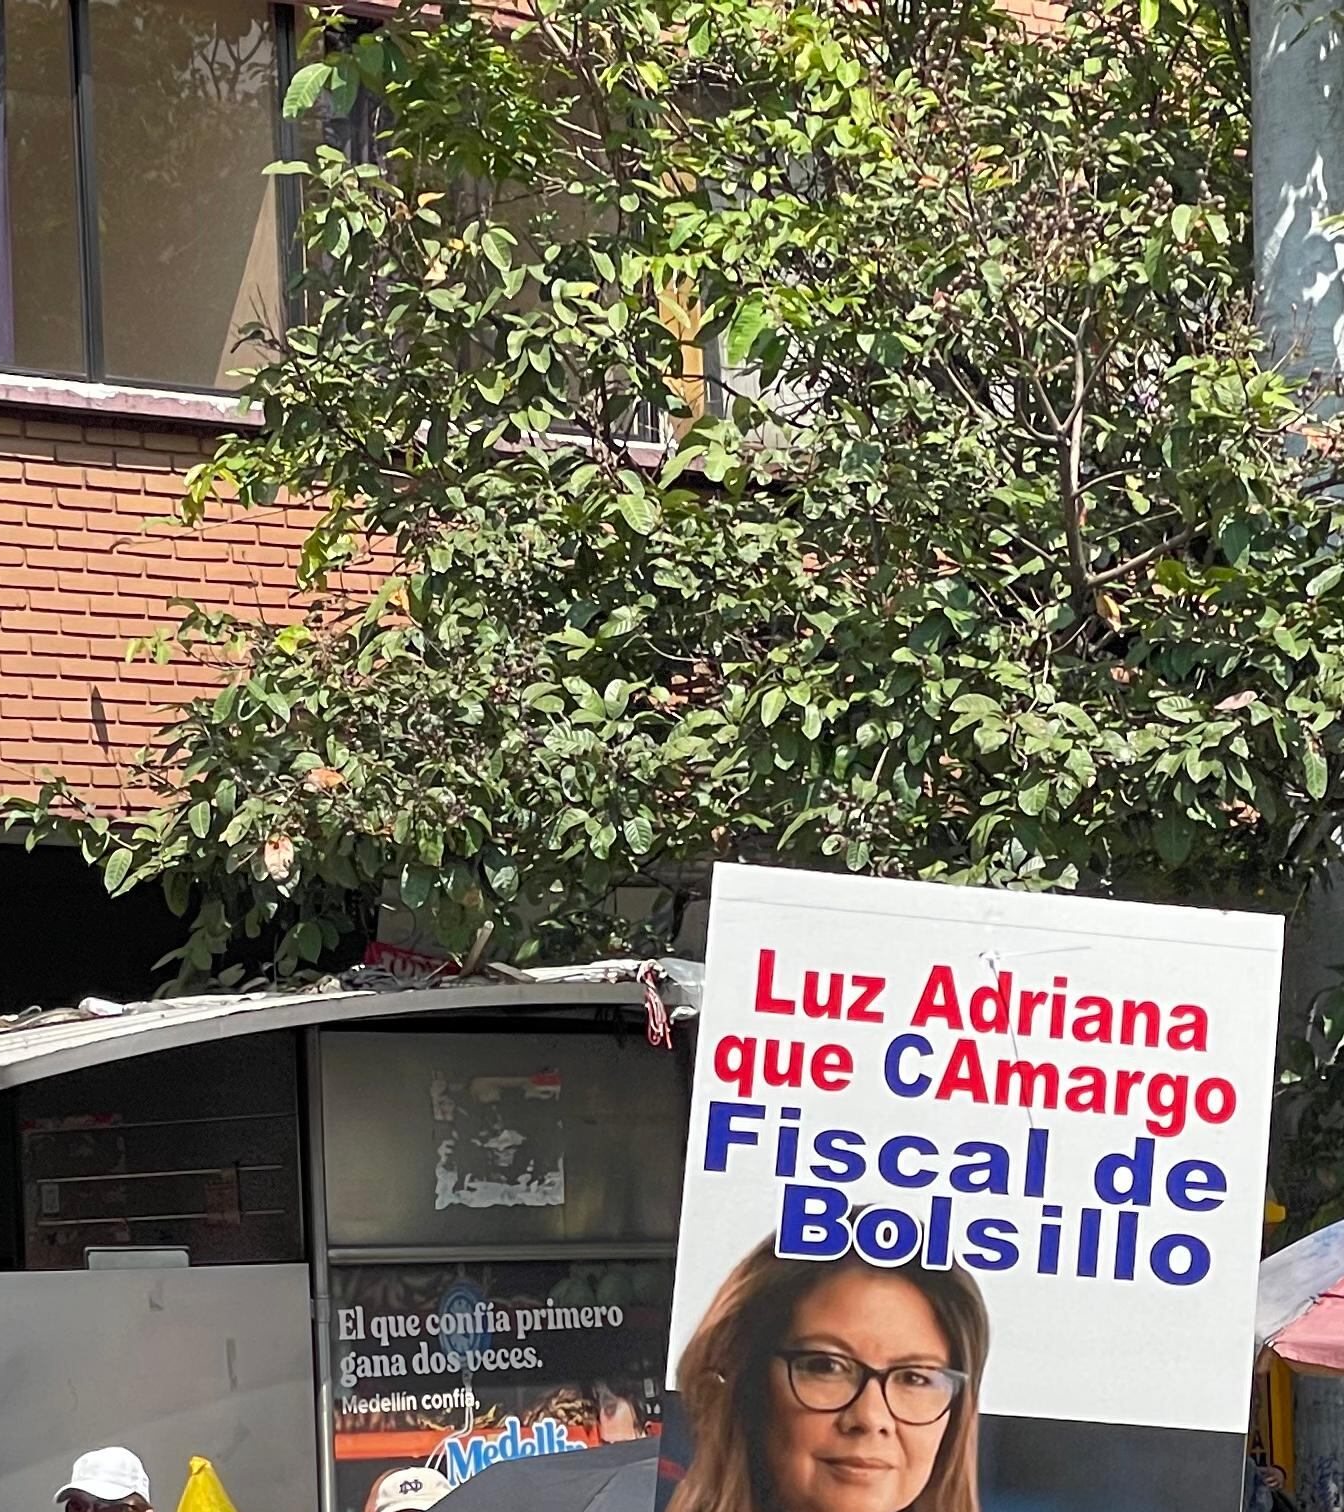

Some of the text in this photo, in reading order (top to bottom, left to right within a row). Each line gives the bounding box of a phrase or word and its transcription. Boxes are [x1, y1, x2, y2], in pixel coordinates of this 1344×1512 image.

[754, 948, 1209, 1053] Luz Adriana
[713, 1033, 1238, 1138] que CAmargo
[704, 1101, 1227, 1213] Fiscal de
[778, 1183, 1212, 1287] Bolsillo
[337, 1297, 625, 1347] El que confía primero
[339, 1340, 544, 1389] gana dos veces.
[341, 1387, 481, 1416] Medellín confía,
